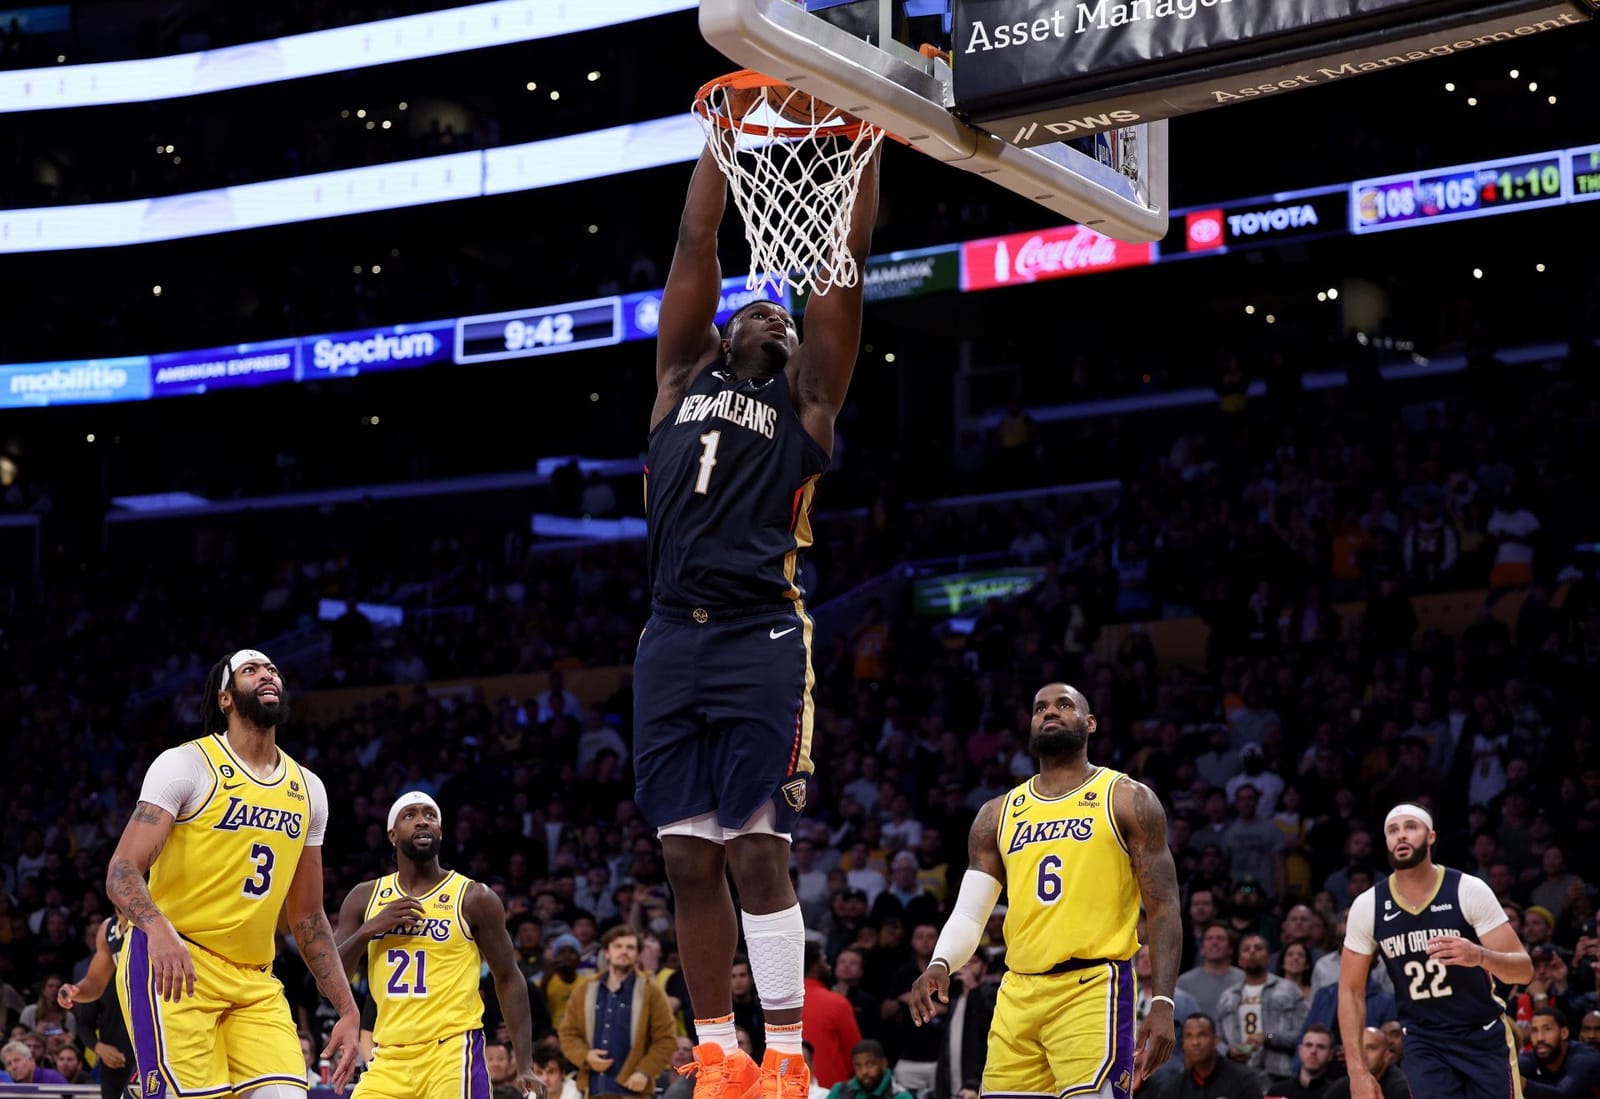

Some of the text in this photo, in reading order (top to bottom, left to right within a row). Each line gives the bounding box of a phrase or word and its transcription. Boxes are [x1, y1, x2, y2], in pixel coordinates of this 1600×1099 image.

[964, 0, 1233, 54] Asset Manag
[1043, 11, 1581, 136] DWS Asset Management
[1435, 177, 1477, 211] 105
[1498, 164, 1561, 201] 1:10
[1227, 204, 1319, 237] TOYOTA
[503, 312, 574, 352] 9:42
[155, 352, 291, 384] AMERICAN EXPRESS
[312, 332, 435, 373] Spectrum
[674, 389, 778, 440] NEW RLEANS
[693, 429, 722, 495] 1
[221, 766, 233, 778] 6
[287, 790, 305, 802] bibigo
[1015, 796, 1024, 807] 6
[1077, 800, 1101, 809] bibigo
[213, 796, 303, 840] LAKERS
[1006, 816, 1094, 856] LAKERS
[243, 842, 276, 898] 3
[1036, 853, 1063, 903] 6
[1380, 933, 1406, 960] NEW
[387, 949, 428, 997] 21
[1404, 960, 1453, 1001] 22
[1245, 1012, 1257, 1035] 8
